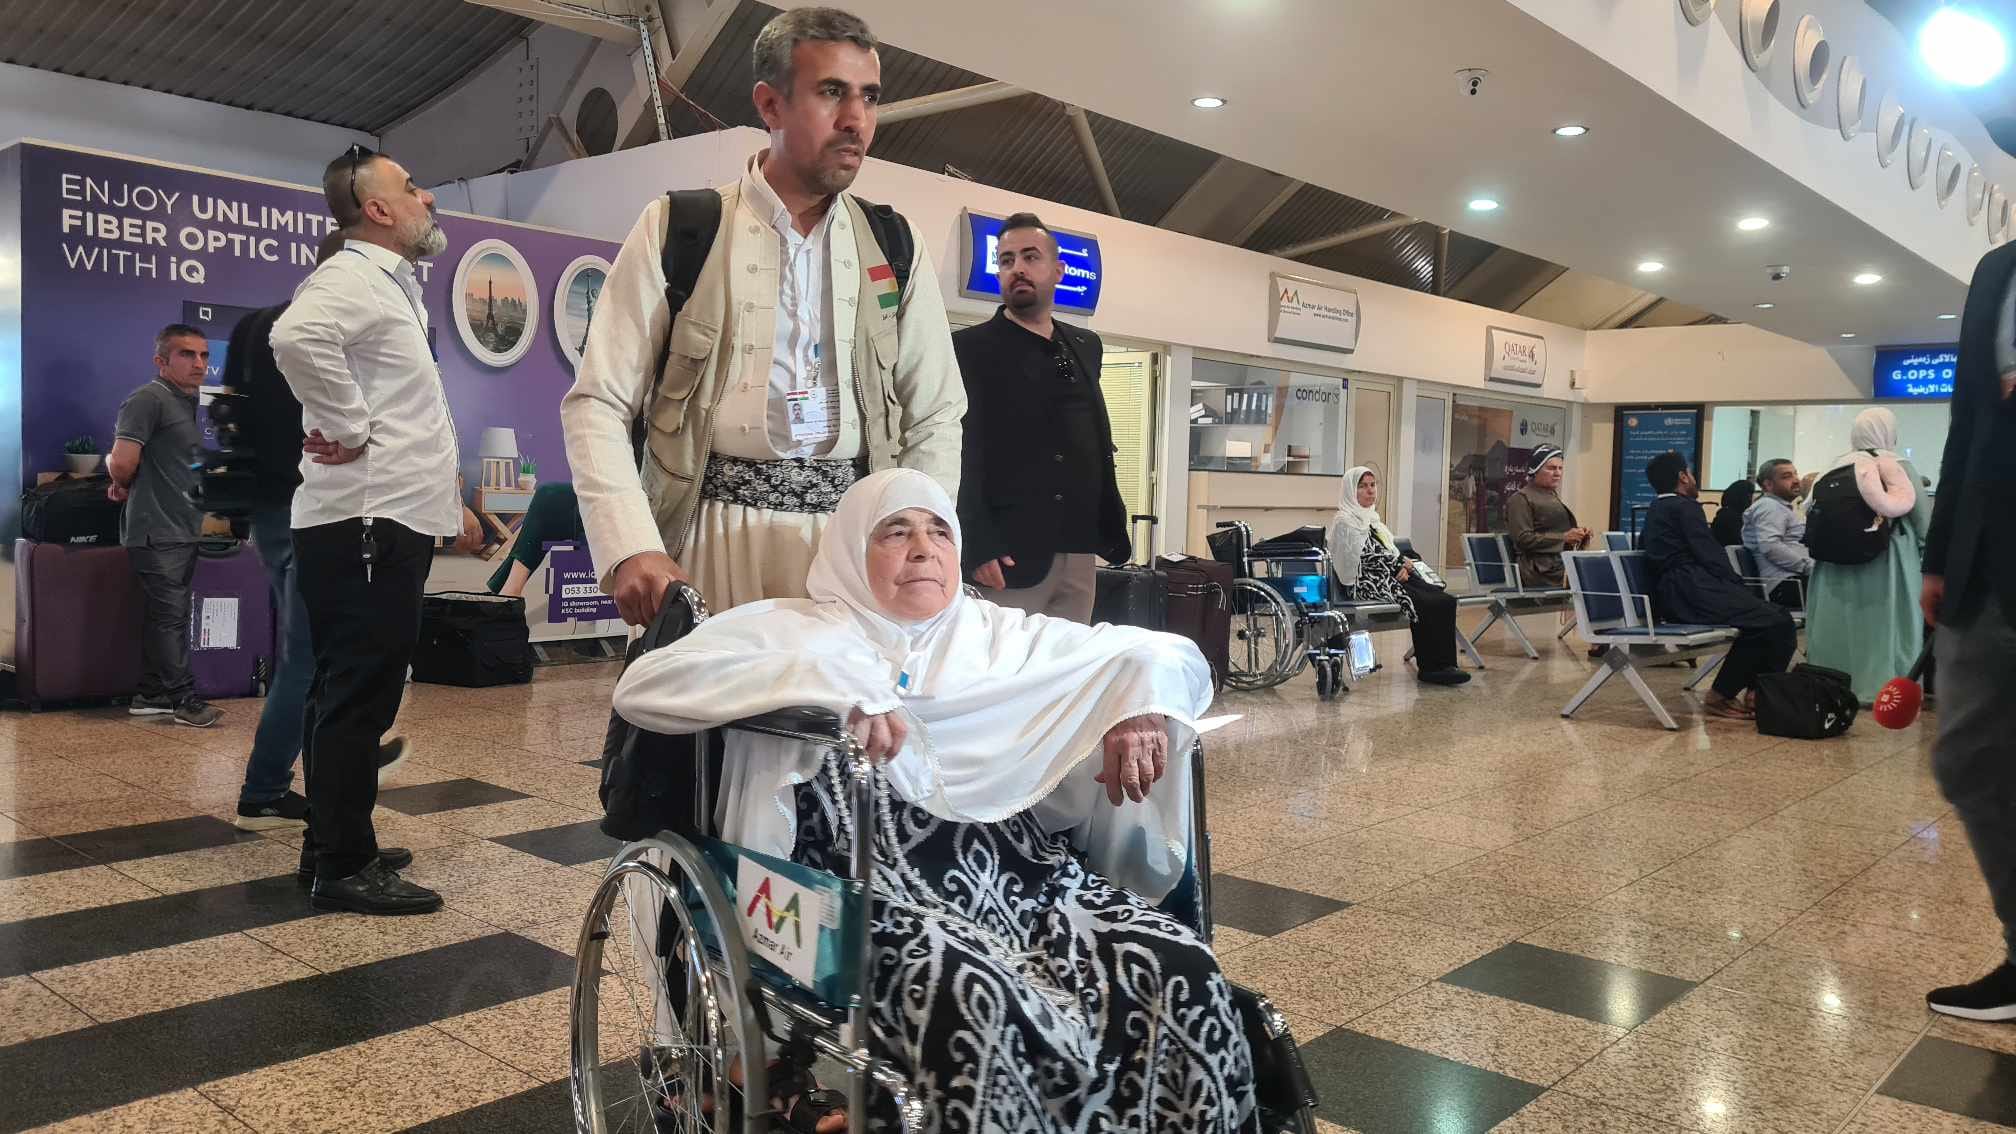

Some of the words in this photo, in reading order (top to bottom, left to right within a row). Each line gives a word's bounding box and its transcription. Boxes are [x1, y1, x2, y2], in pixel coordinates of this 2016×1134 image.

[61, 173, 181, 215] ENJOY
[192, 194, 341, 237] UNLIMITE
[62, 208, 168, 247] FIBER
[179, 226, 279, 262] OPTIC
[62, 242, 156, 279] WITH
[170, 256, 206, 285] iQ
[1892, 369, 1935, 380] G.OPS
[1296, 387, 1331, 402] condor
[565, 587, 581, 595] 053
